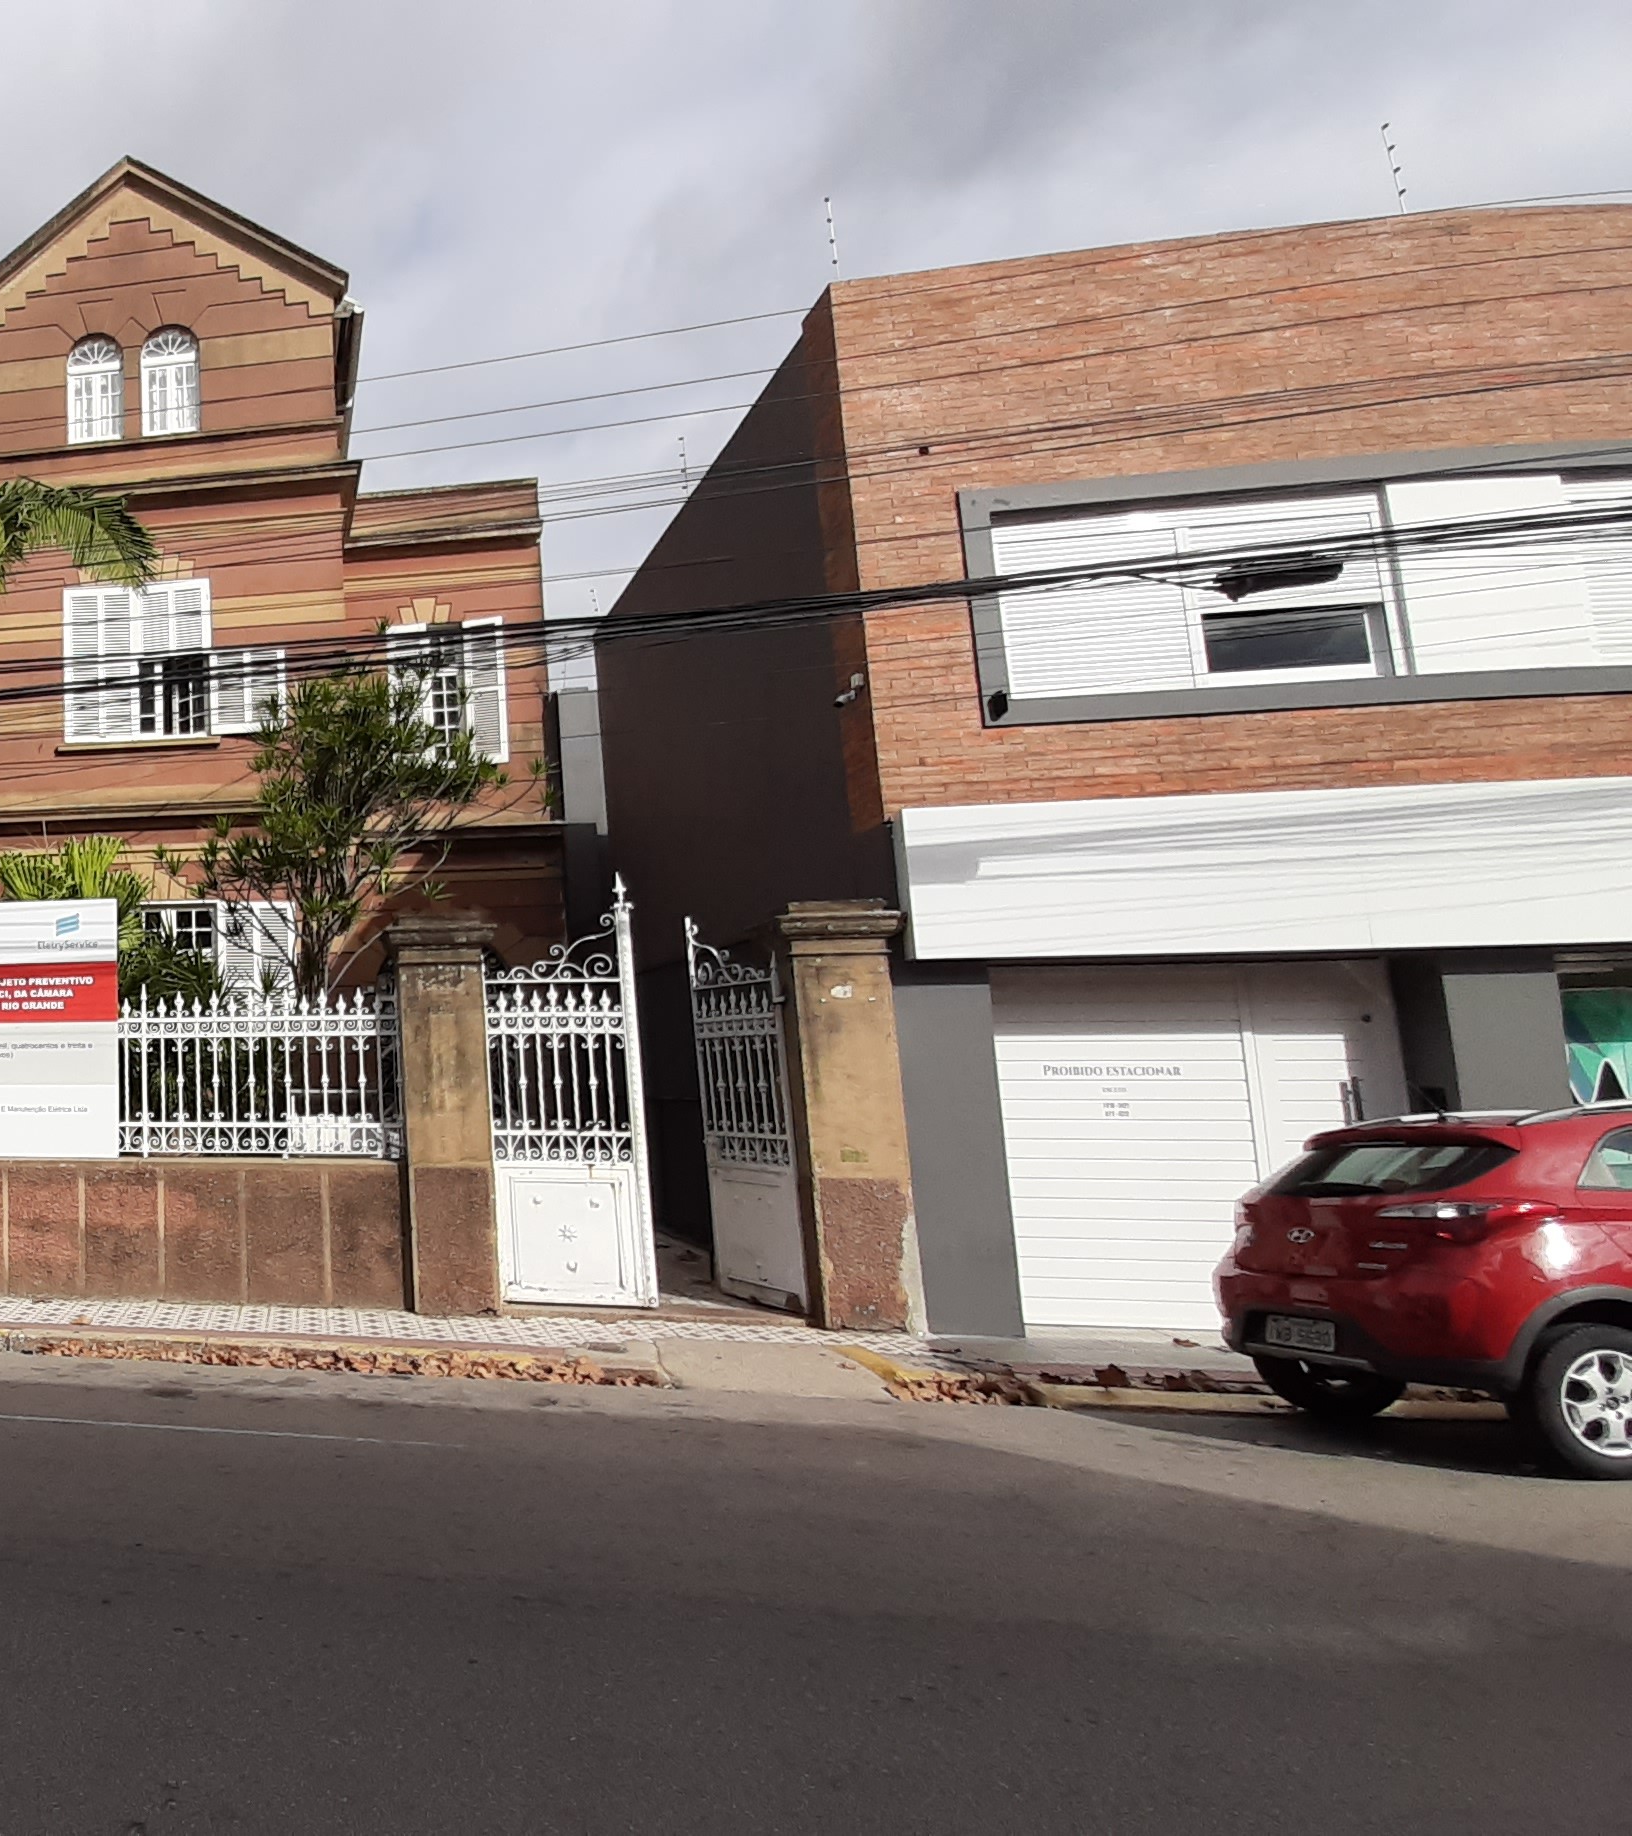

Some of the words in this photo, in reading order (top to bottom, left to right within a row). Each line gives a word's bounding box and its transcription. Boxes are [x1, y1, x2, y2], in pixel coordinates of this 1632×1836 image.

[28, 976, 94, 986] PREVENTIVO
[13, 990, 27, 998] DA
[29, 987, 74, 998] CÂMARA
[1, 1002, 19, 1010] RIO
[21, 1001, 65, 1010] GRANDE
[1043, 1065, 1103, 1076] PROIBIDO
[1106, 1066, 1182, 1076] ESTACIONAR
